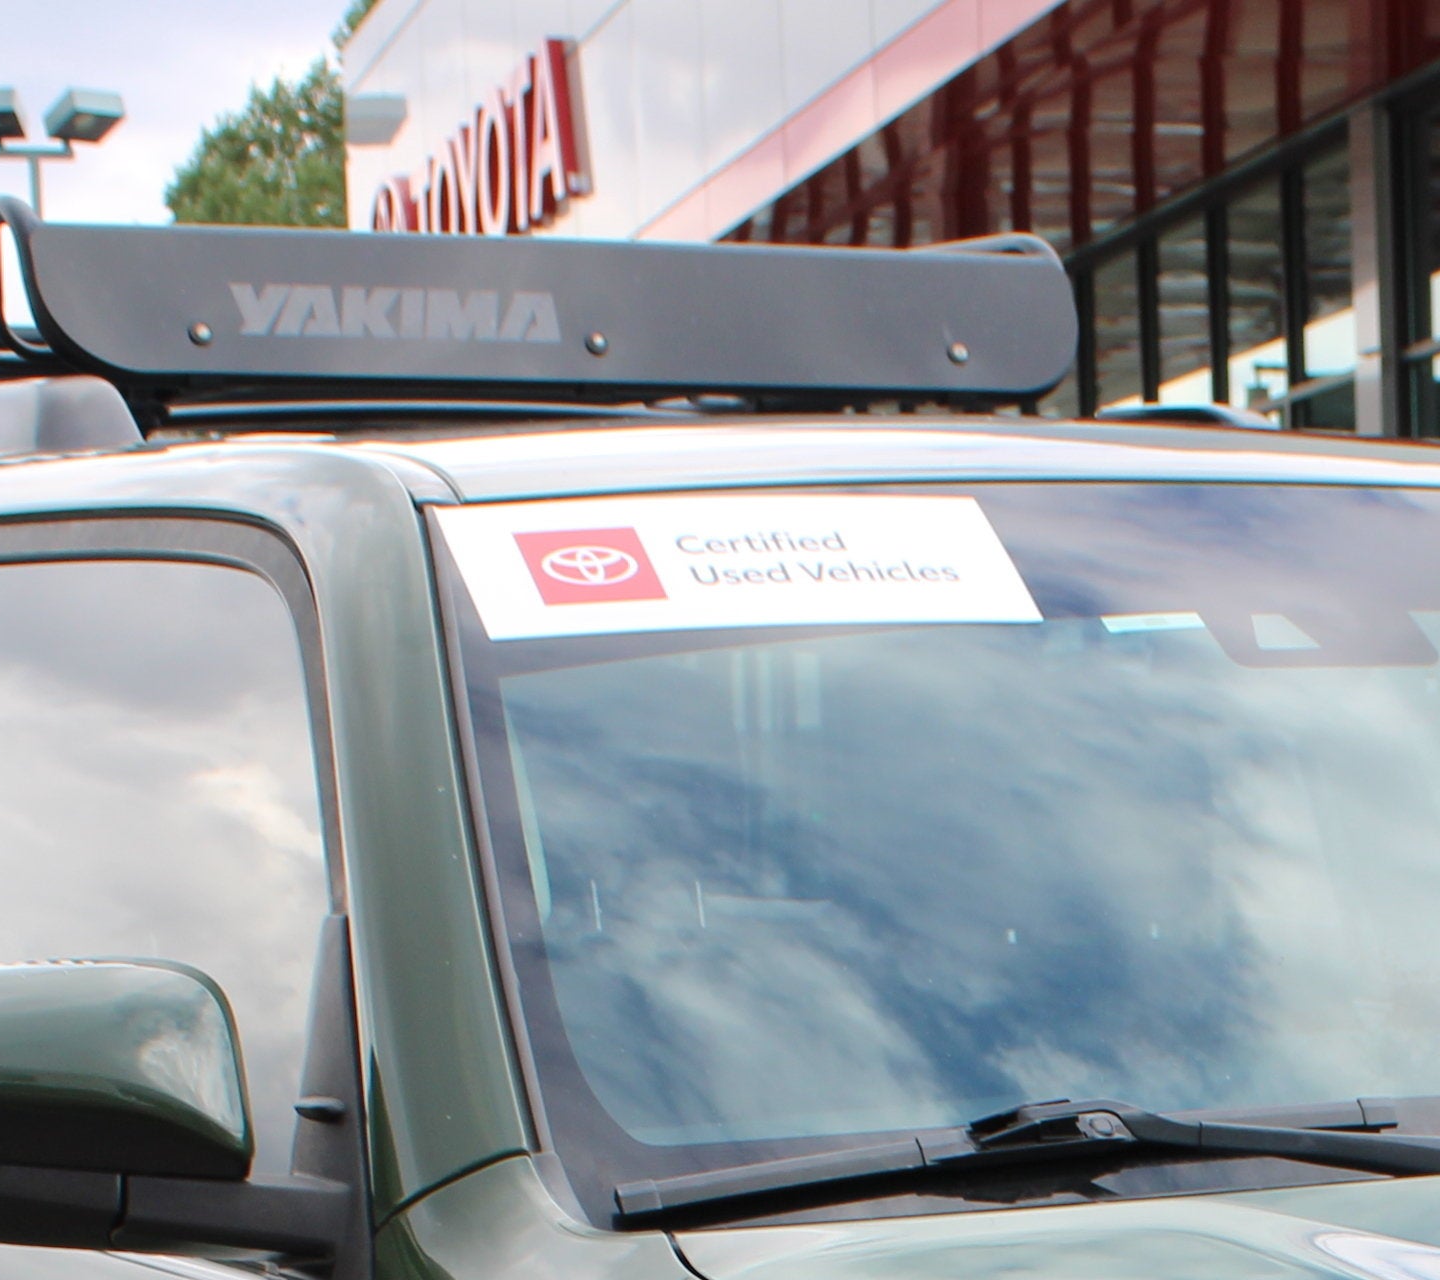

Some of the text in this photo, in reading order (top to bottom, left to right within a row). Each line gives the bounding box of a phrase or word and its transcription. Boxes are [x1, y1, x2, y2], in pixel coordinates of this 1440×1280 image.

[409, 36, 583, 236] TOYOTA
[228, 282, 563, 344] YAKIMA
[673, 531, 847, 556] Certified
[688, 559, 960, 586] Used Vehicles
